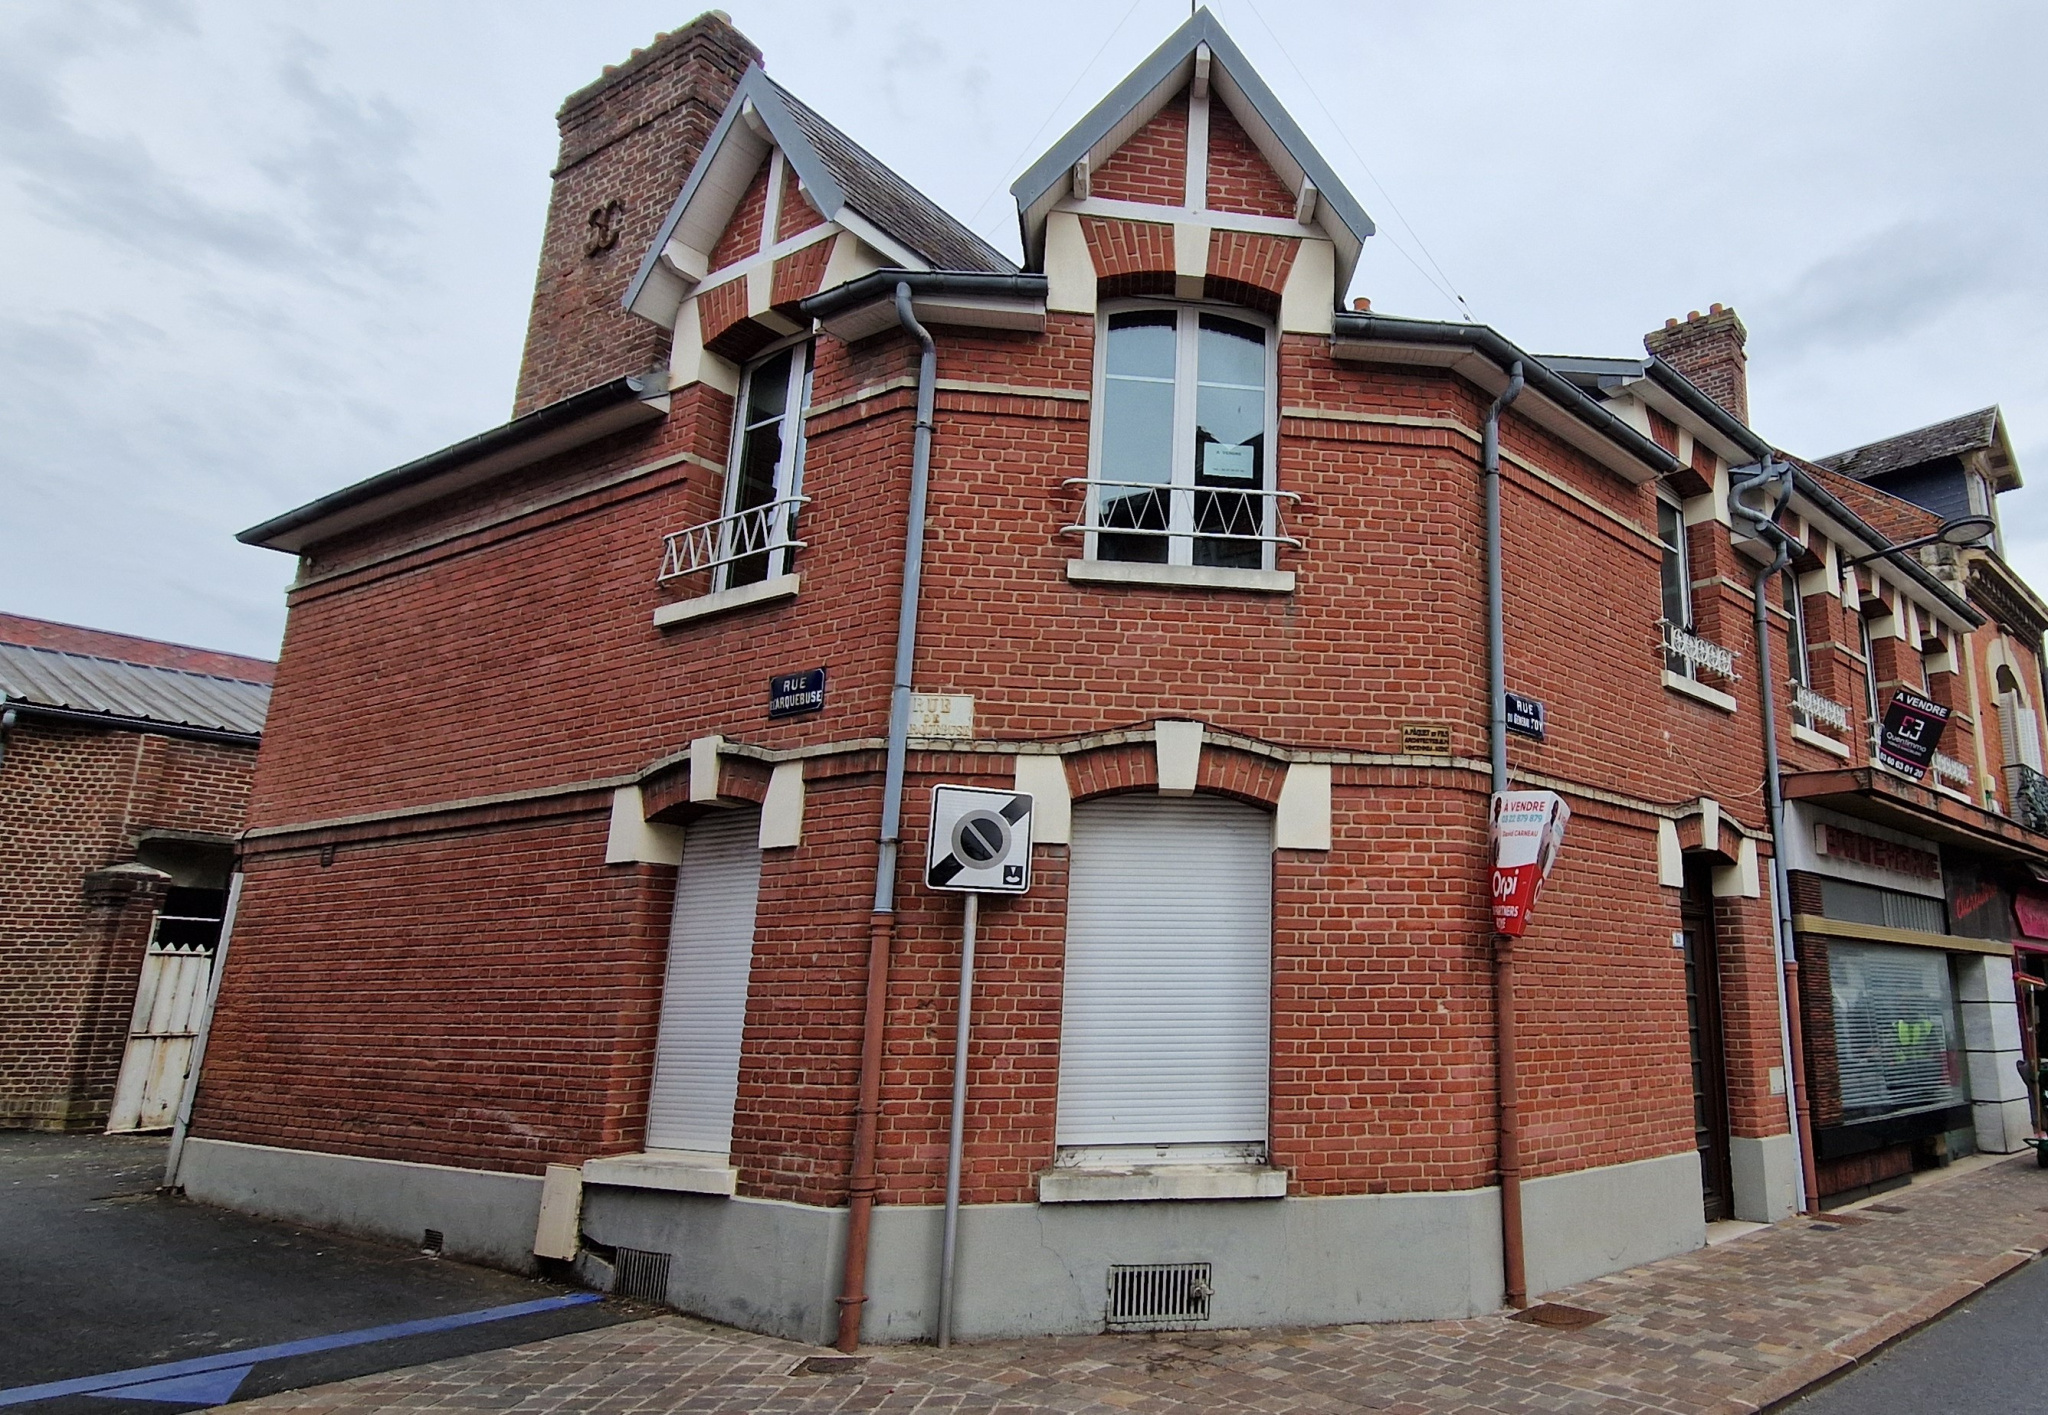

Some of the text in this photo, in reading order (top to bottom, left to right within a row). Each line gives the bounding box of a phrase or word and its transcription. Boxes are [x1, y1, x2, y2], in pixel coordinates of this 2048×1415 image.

[783, 677, 807, 692] RUE
[913, 697, 951, 713] RUE
[1516, 700, 1534, 715] RUE
[1896, 692, 1947, 717] A VENDRE
[1904, 765, 1914, 774] 01
[1914, 769, 1923, 778] 20
[1511, 801, 1545, 812] VENDRE
[1492, 868, 1519, 902] Orpi
